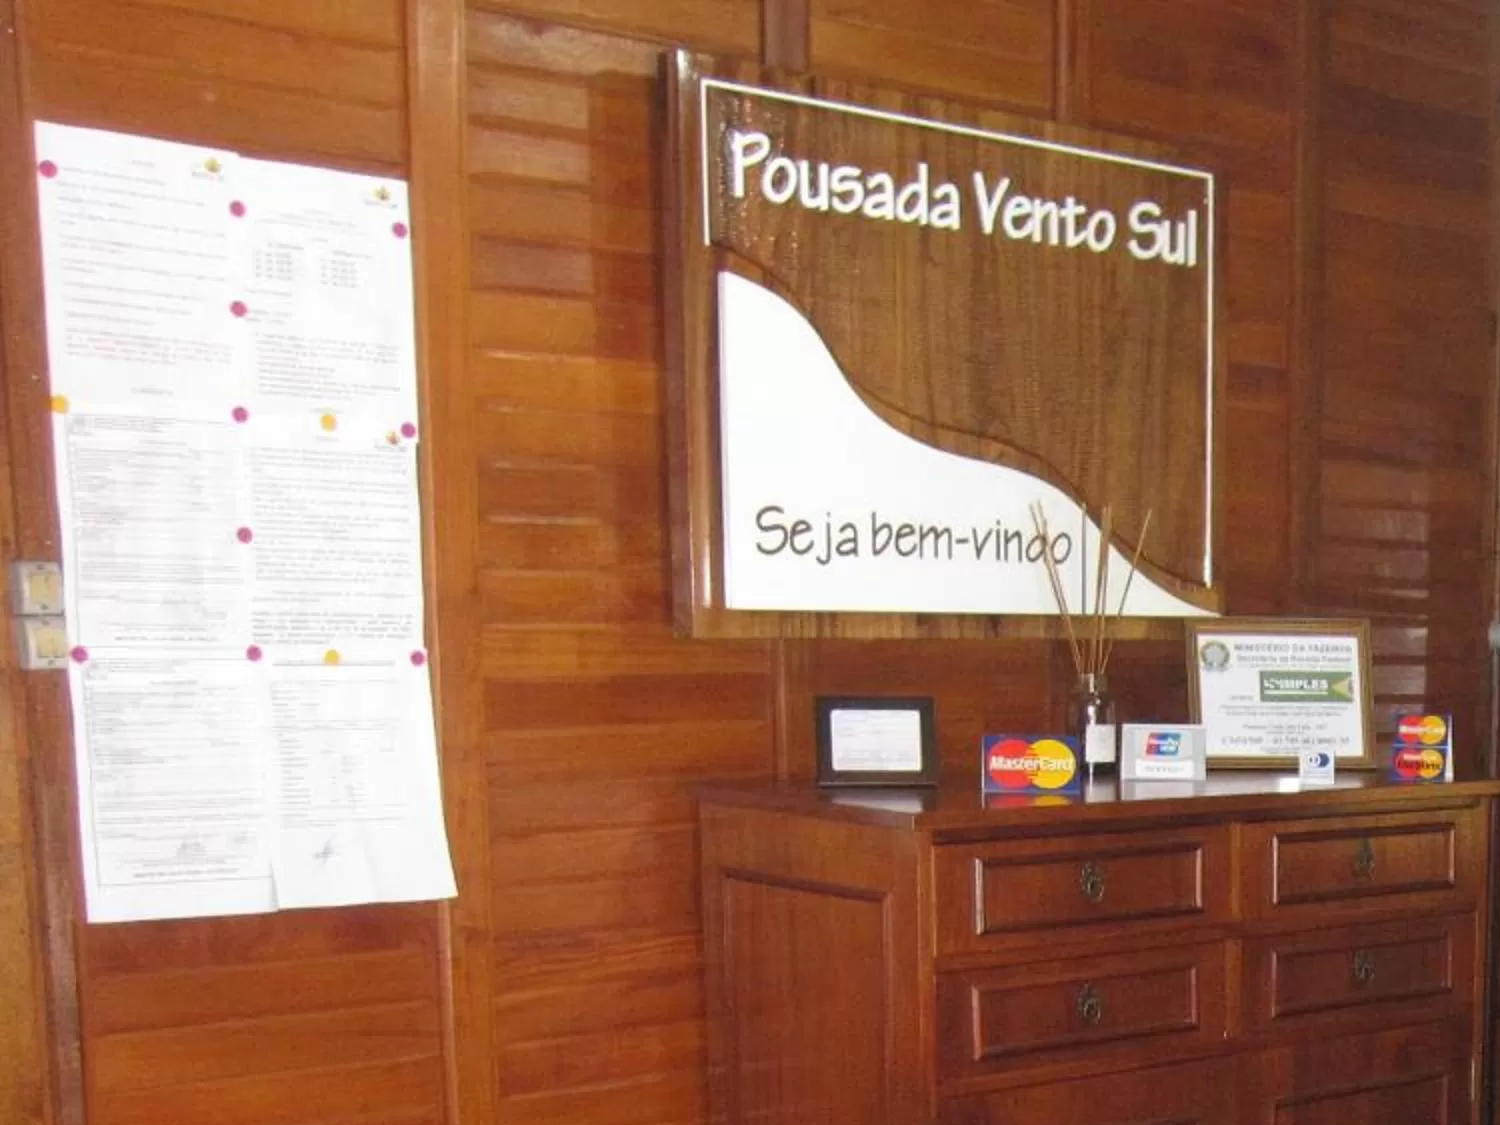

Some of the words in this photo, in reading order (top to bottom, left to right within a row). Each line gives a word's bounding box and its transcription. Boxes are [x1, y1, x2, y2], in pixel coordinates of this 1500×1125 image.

[732, 131, 961, 231] Pousada
[973, 171, 1117, 252] Vento
[1127, 201, 1198, 268] Sul
[755, 505, 859, 565] Seja
[871, 511, 1073, 565] bem-vindo
[989, 755, 1076, 773] MasterCard
